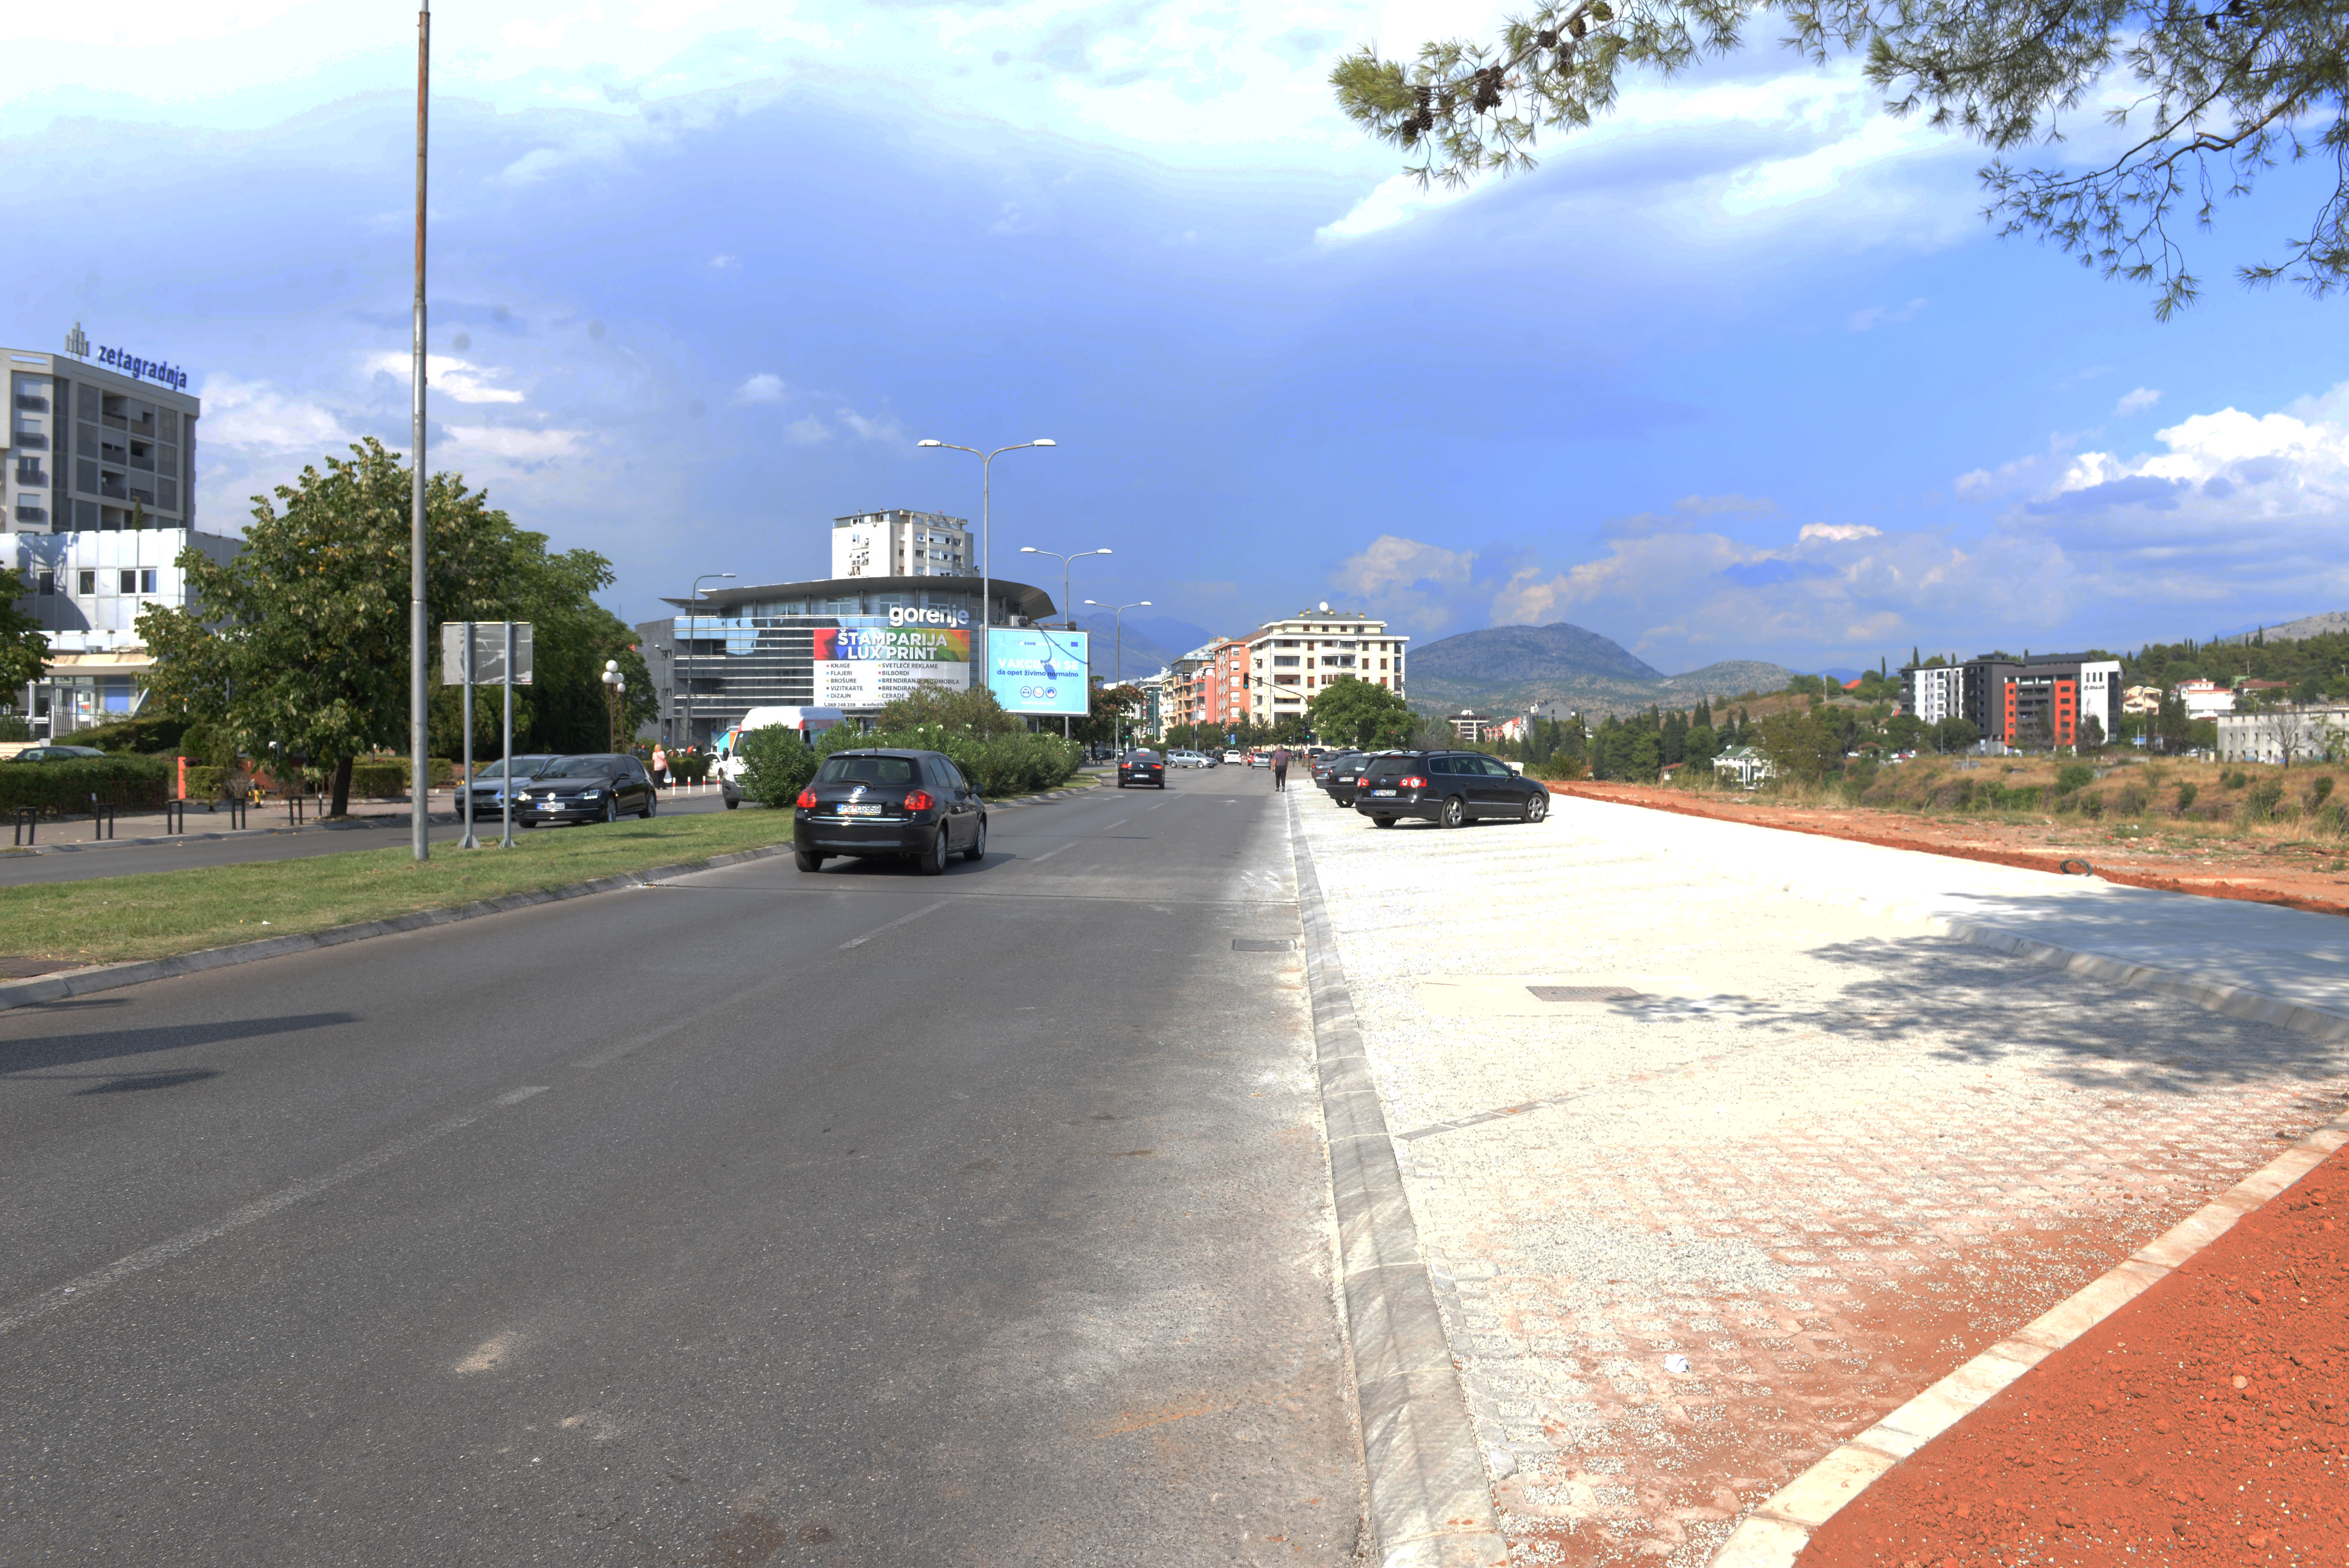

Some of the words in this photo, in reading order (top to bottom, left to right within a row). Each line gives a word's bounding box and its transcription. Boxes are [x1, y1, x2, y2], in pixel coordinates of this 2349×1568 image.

[99, 345, 187, 390] zetagradnja
[889, 605, 970, 627] gorenje
[838, 629, 948, 647] ŠTAMPARIJA
[848, 647, 882, 660] LUX
[886, 647, 937, 660] PRINT
[1064, 660, 1079, 670] SE
